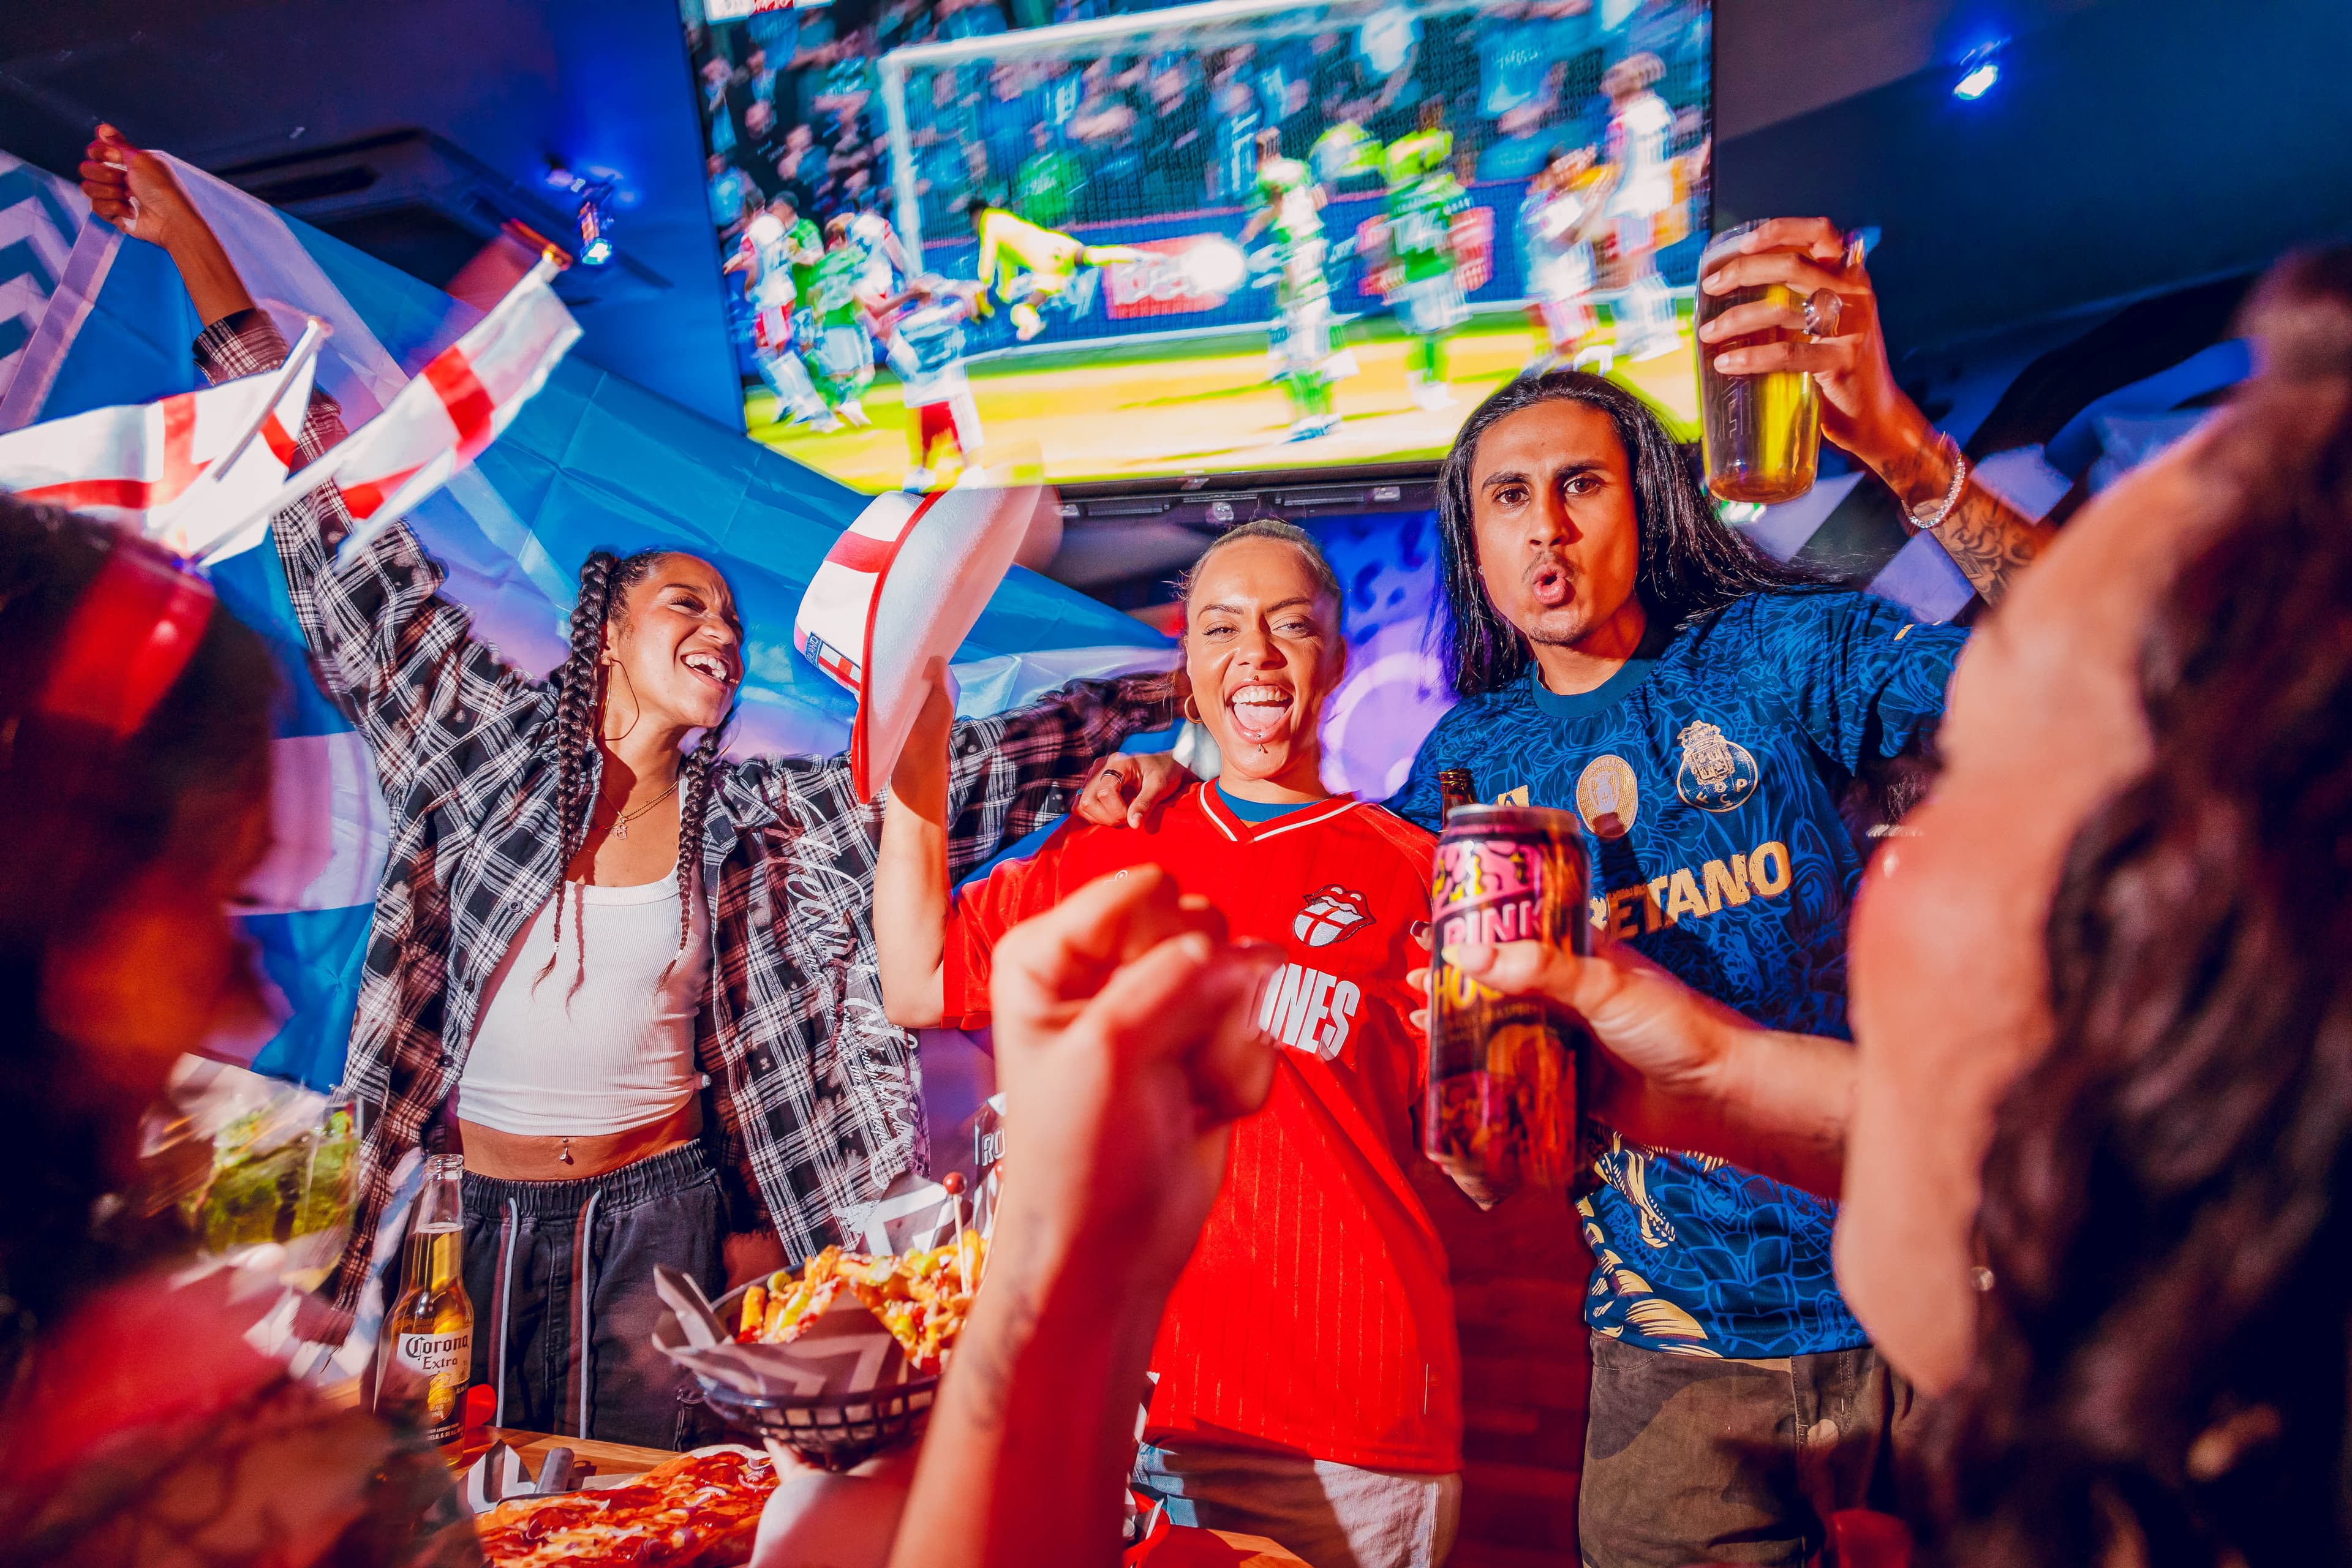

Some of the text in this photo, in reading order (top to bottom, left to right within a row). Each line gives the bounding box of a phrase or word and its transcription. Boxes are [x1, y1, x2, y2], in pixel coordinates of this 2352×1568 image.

[1258, 962, 1361, 1061] ONES
[405, 1335, 469, 1360] Corona
[422, 1356, 458, 1370] Extra
